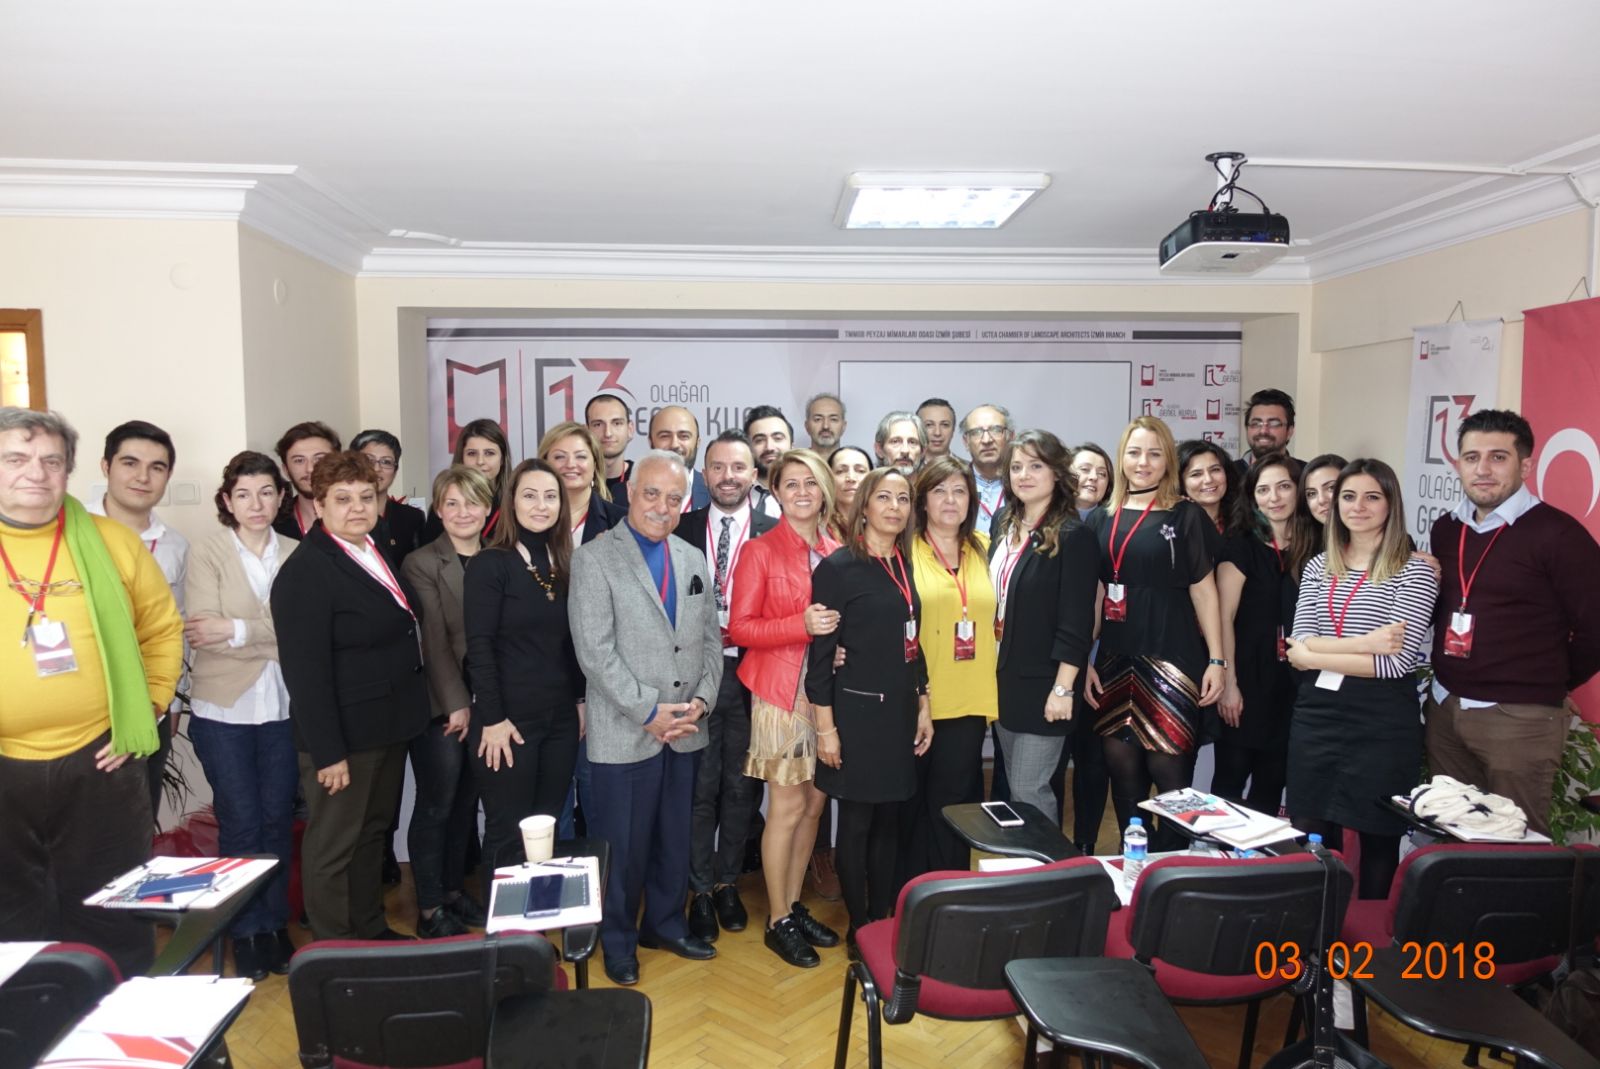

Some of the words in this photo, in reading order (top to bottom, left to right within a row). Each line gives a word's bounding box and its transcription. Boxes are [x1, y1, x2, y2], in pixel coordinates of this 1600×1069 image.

[866, 330, 885, 338] PEYZAJ
[918, 330, 934, 338] ODASI
[982, 331, 998, 339] UCTEA
[999, 331, 1024, 339] CHAMBER
[1031, 331, 1059, 339] LANDSCAPE
[1060, 331, 1090, 339] ARCHITECTS
[1105, 331, 1126, 339] BRANCH
[650, 381, 709, 403] OLAĞAN
[1419, 471, 1465, 502] OLAĞA
